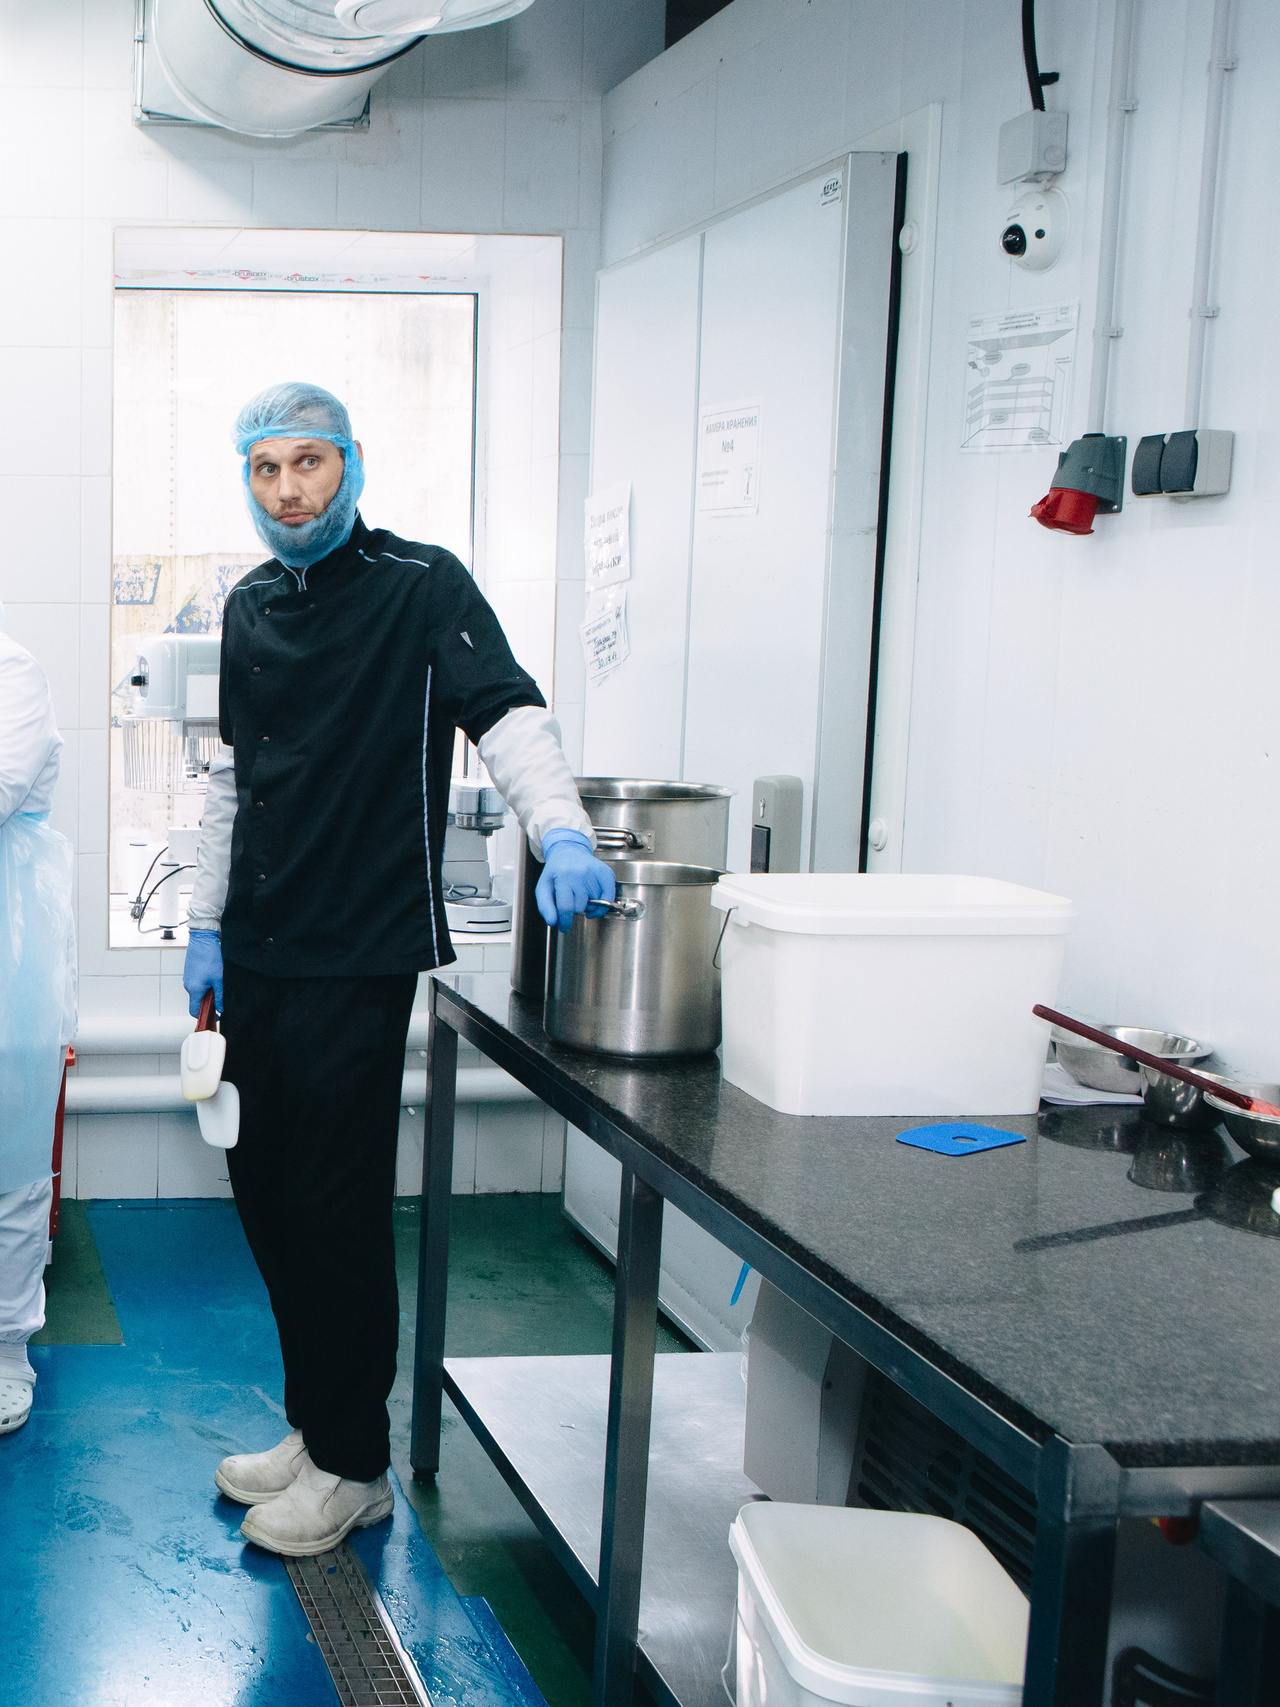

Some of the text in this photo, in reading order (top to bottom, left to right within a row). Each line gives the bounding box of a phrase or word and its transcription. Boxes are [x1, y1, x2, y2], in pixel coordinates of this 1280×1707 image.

[705, 415, 758, 434] КАМЕРА ХРАНЕНИЯ
[722, 439, 734, 453] №4
